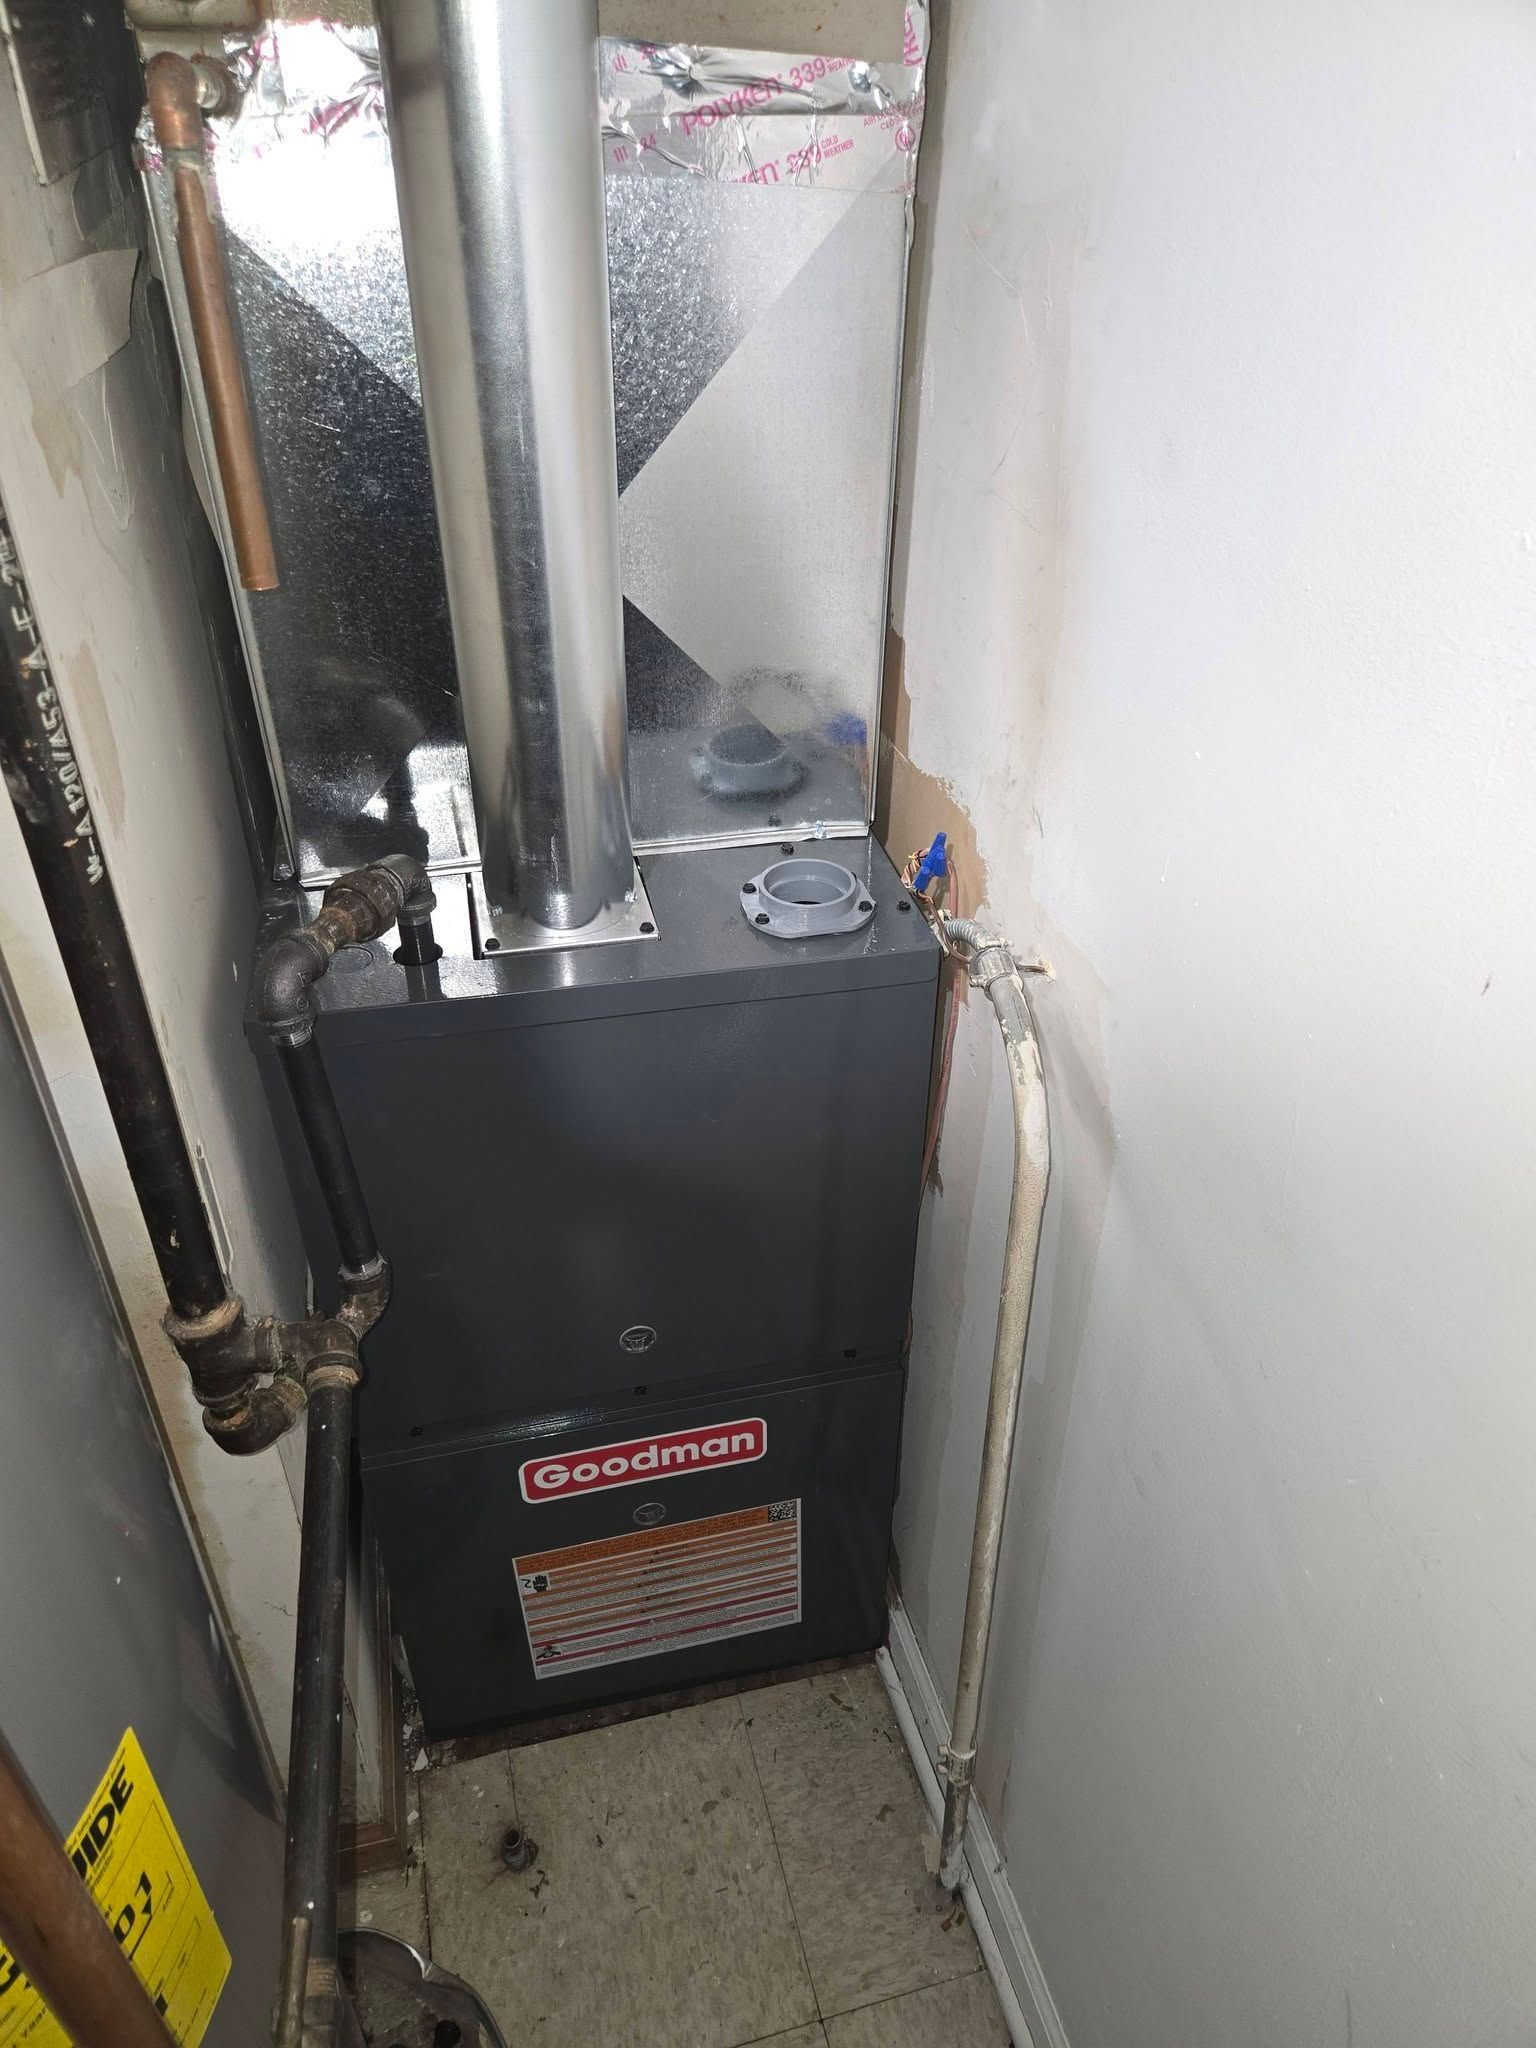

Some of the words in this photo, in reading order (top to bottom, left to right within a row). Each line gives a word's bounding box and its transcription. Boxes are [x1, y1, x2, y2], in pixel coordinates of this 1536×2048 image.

[789, 57, 827, 89] 339
[820, 134, 839, 150] COLD
[823, 138, 856, 160] WEATHER
[532, 1431, 756, 1490] Goodman
